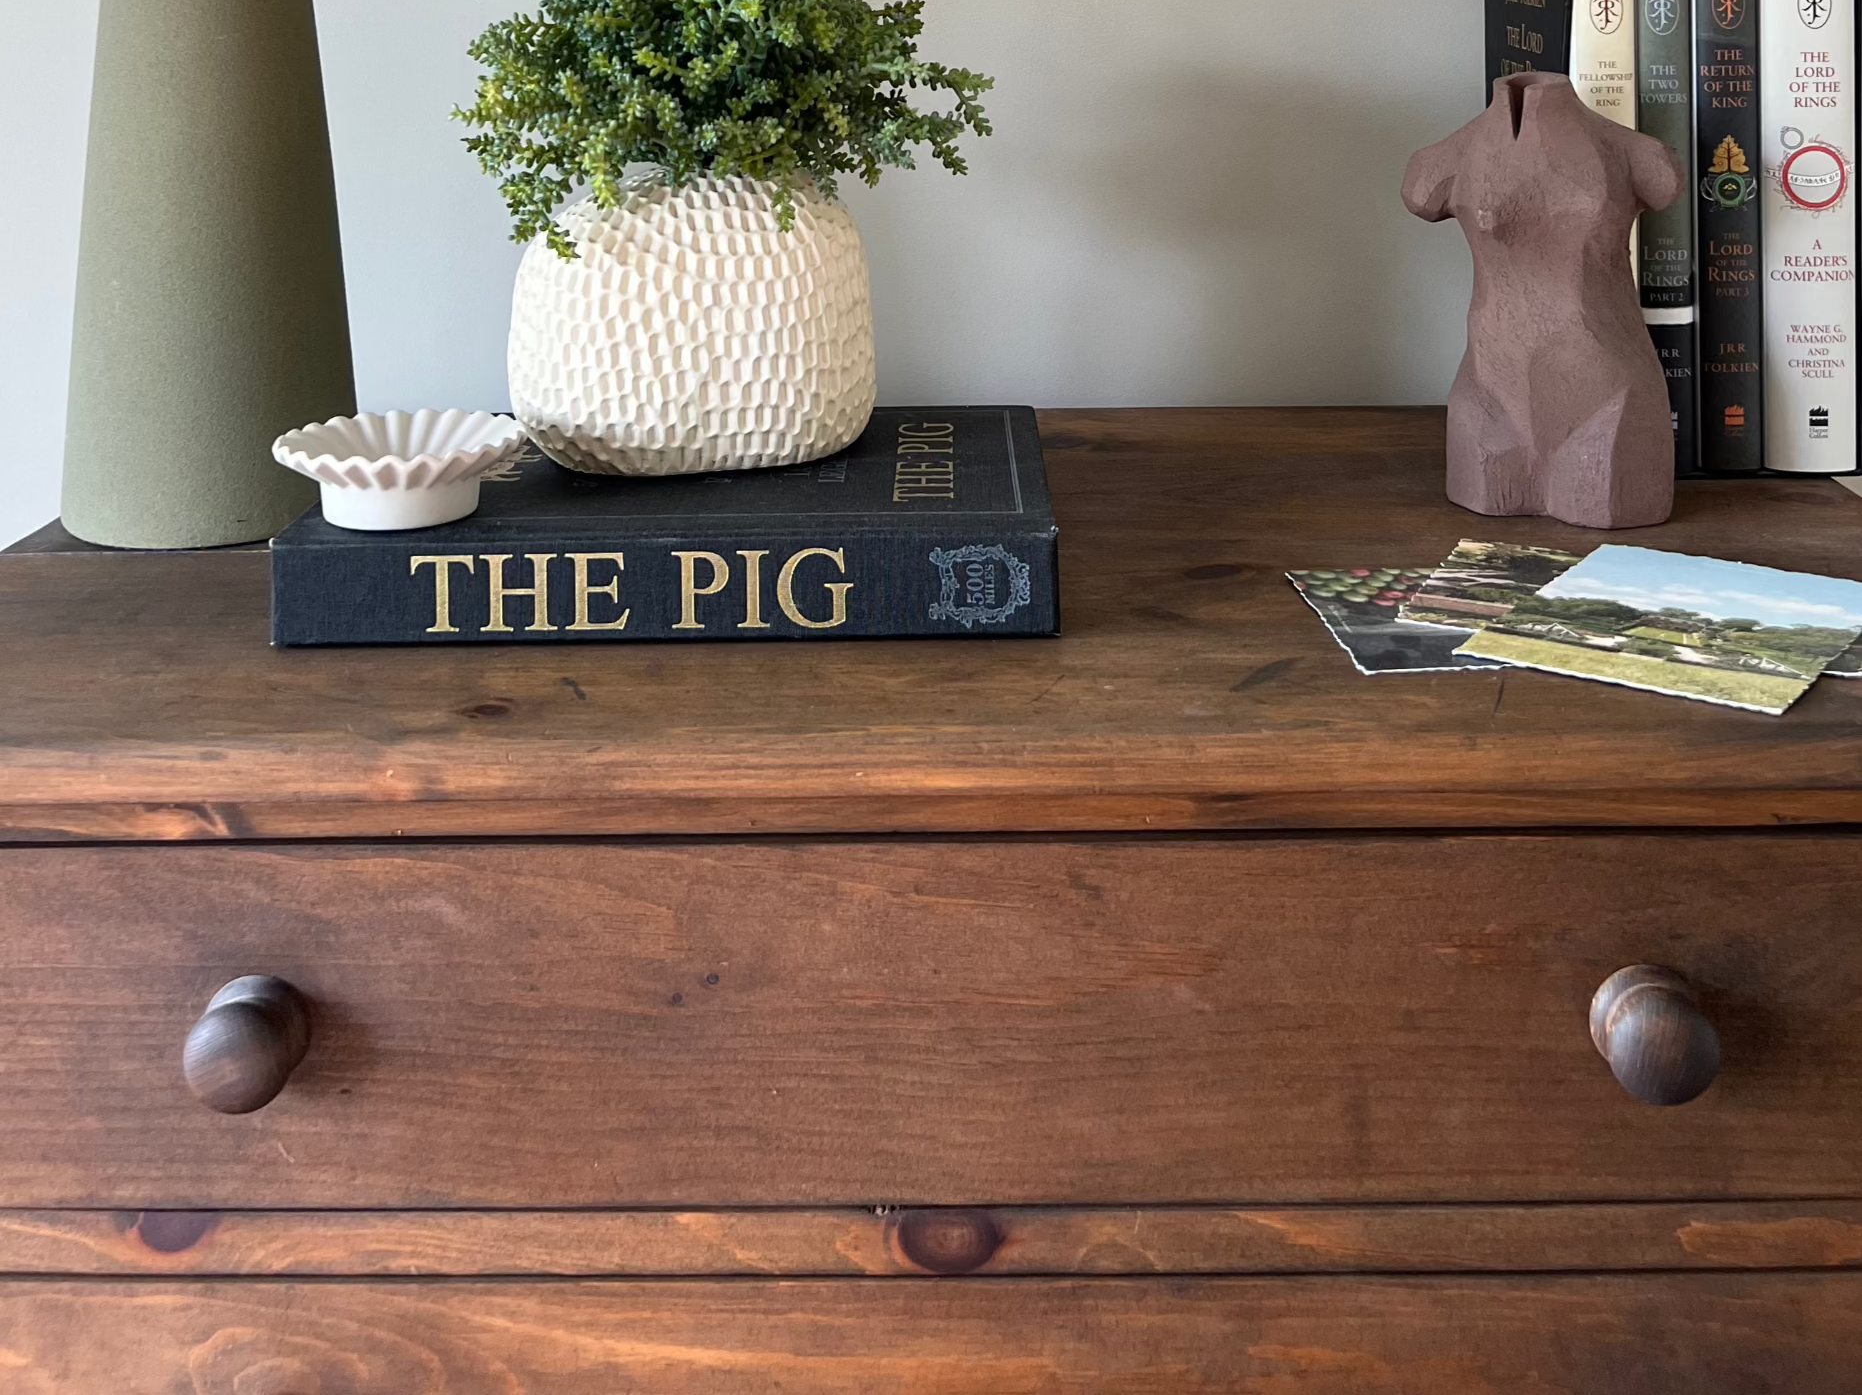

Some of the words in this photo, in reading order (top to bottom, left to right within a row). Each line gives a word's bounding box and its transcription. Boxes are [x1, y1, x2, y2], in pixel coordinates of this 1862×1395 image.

[1506, 26, 1520, 48] THE
[1521, 23, 1544, 54] LORD
[1714, 50, 1744, 61] THE
[1800, 52, 1830, 63] THE
[1597, 61, 1618, 69] THE
[1649, 65, 1677, 76] THE
[1579, 72, 1634, 81] FELLOWSHIP
[1700, 65, 1755, 77] RETURN
[1795, 66, 1836, 78] LORD
[1590, 86, 1604, 94] OF
[1605, 86, 1625, 94] THE
[1648, 79, 1679, 90] TWO
[1704, 81, 1723, 93] OF
[1726, 81, 1753, 92] THE
[1789, 82, 1809, 93] OF
[1812, 82, 1841, 93] THE
[1595, 99, 1622, 107] RING
[1640, 93, 1688, 104] TOWERS
[1712, 96, 1748, 108] KING
[1793, 96, 1837, 108] RINGS
[1657, 237, 1674, 245] THE
[1722, 232, 1740, 240] THE
[1710, 241, 1753, 255] LORD
[1812, 239, 1822, 250] A
[1644, 246, 1688, 261] LORD
[1784, 256, 1848, 267] READER'S
[1642, 272, 1690, 287] RINGS
[1708, 267, 1756, 282] RINGS
[1770, 270, 1855, 281] COMPANION
[1650, 293, 1676, 302] PART
[1678, 293, 1684, 302] 2
[1716, 288, 1742, 297] PART
[1743, 287, 1750, 297] 3
[1790, 324, 1831, 333] WAYNE
[1833, 324, 1844, 333] G.
[1786, 334, 1847, 344] HAMMOND
[1807, 348, 1829, 356] AND
[1703, 362, 1759, 373] TOLKIEN
[1788, 359, 1845, 368] CHRISTINA
[1801, 370, 1834, 378] SCULL
[898, 422, 954, 454] PIG
[893, 460, 954, 502] THE
[966, 563, 984, 605] 500
[984, 564, 996, 605] MILES
[410, 551, 630, 633] THE
[671, 547, 855, 630] PIG
